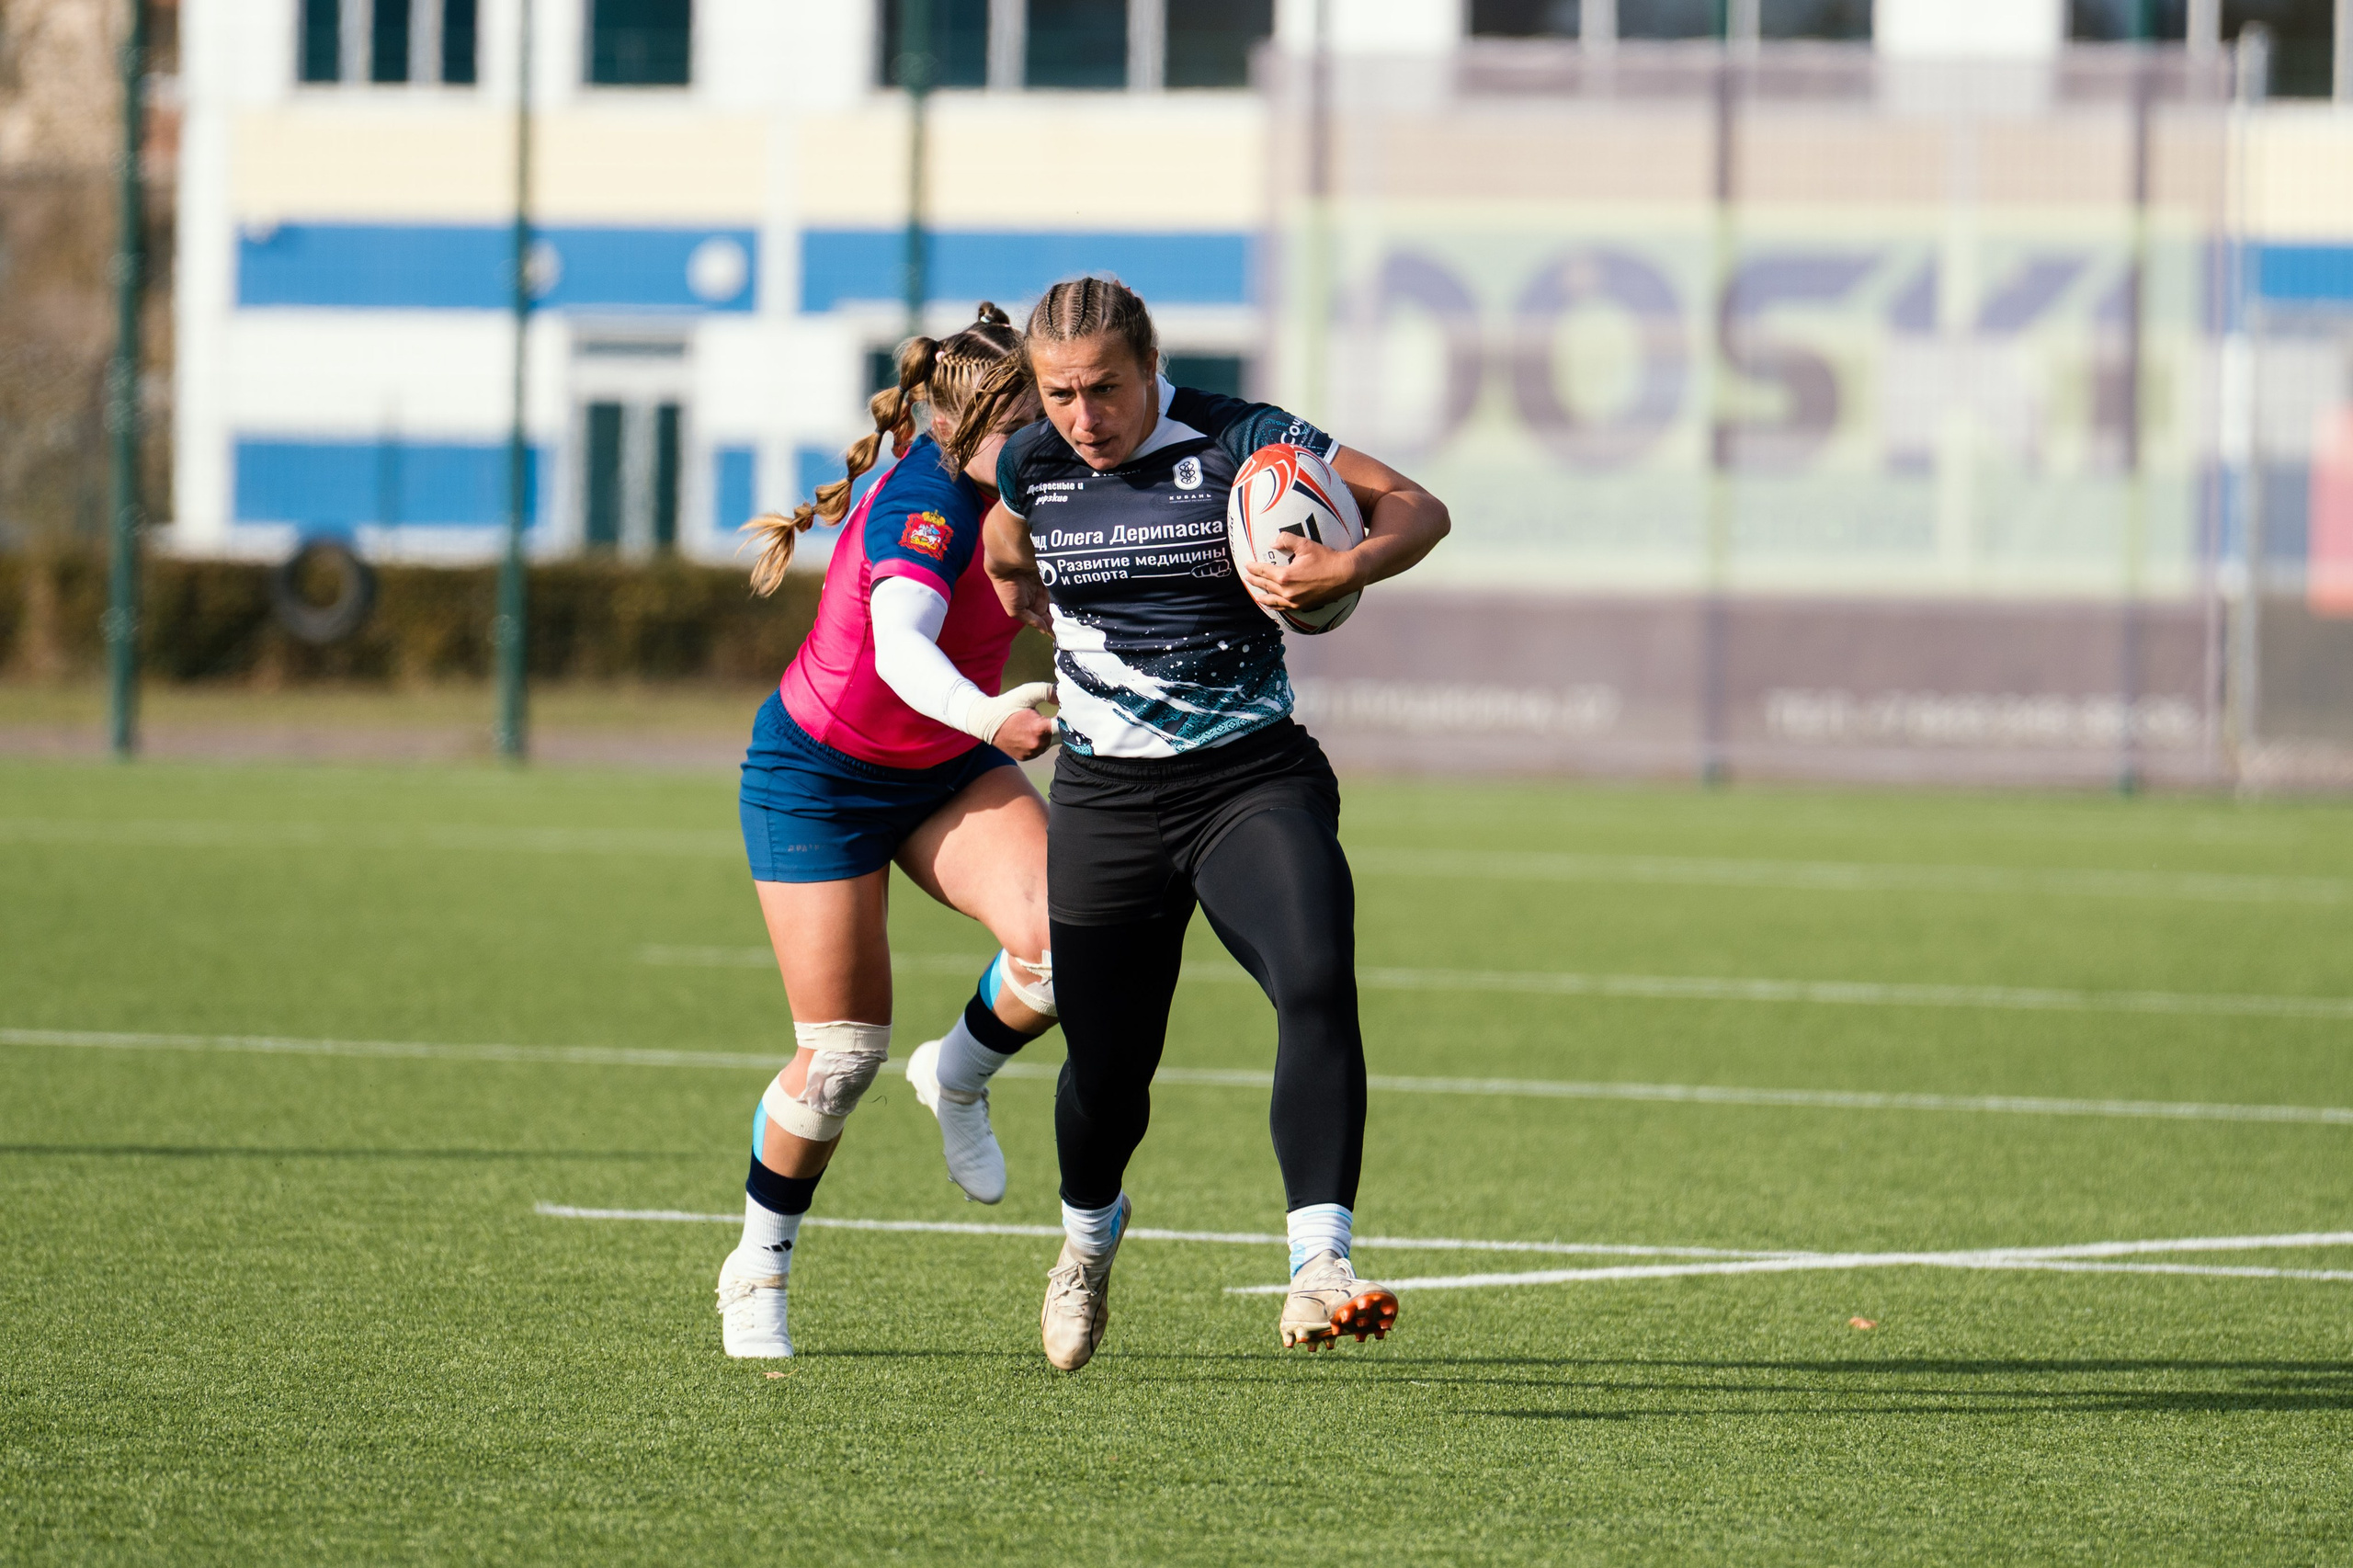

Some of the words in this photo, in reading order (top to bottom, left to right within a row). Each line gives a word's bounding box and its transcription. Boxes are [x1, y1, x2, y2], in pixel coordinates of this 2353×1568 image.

[1077, 482, 1084, 490] и
[1029, 532, 1047, 551] онд
[1051, 529, 1103, 547] Олега
[1109, 520, 1223, 545] Дерипаска
[1057, 556, 1130, 573] Развитие
[1135, 547, 1226, 567] медицины
[1061, 576, 1070, 585] и
[1074, 570, 1129, 584] спорта
